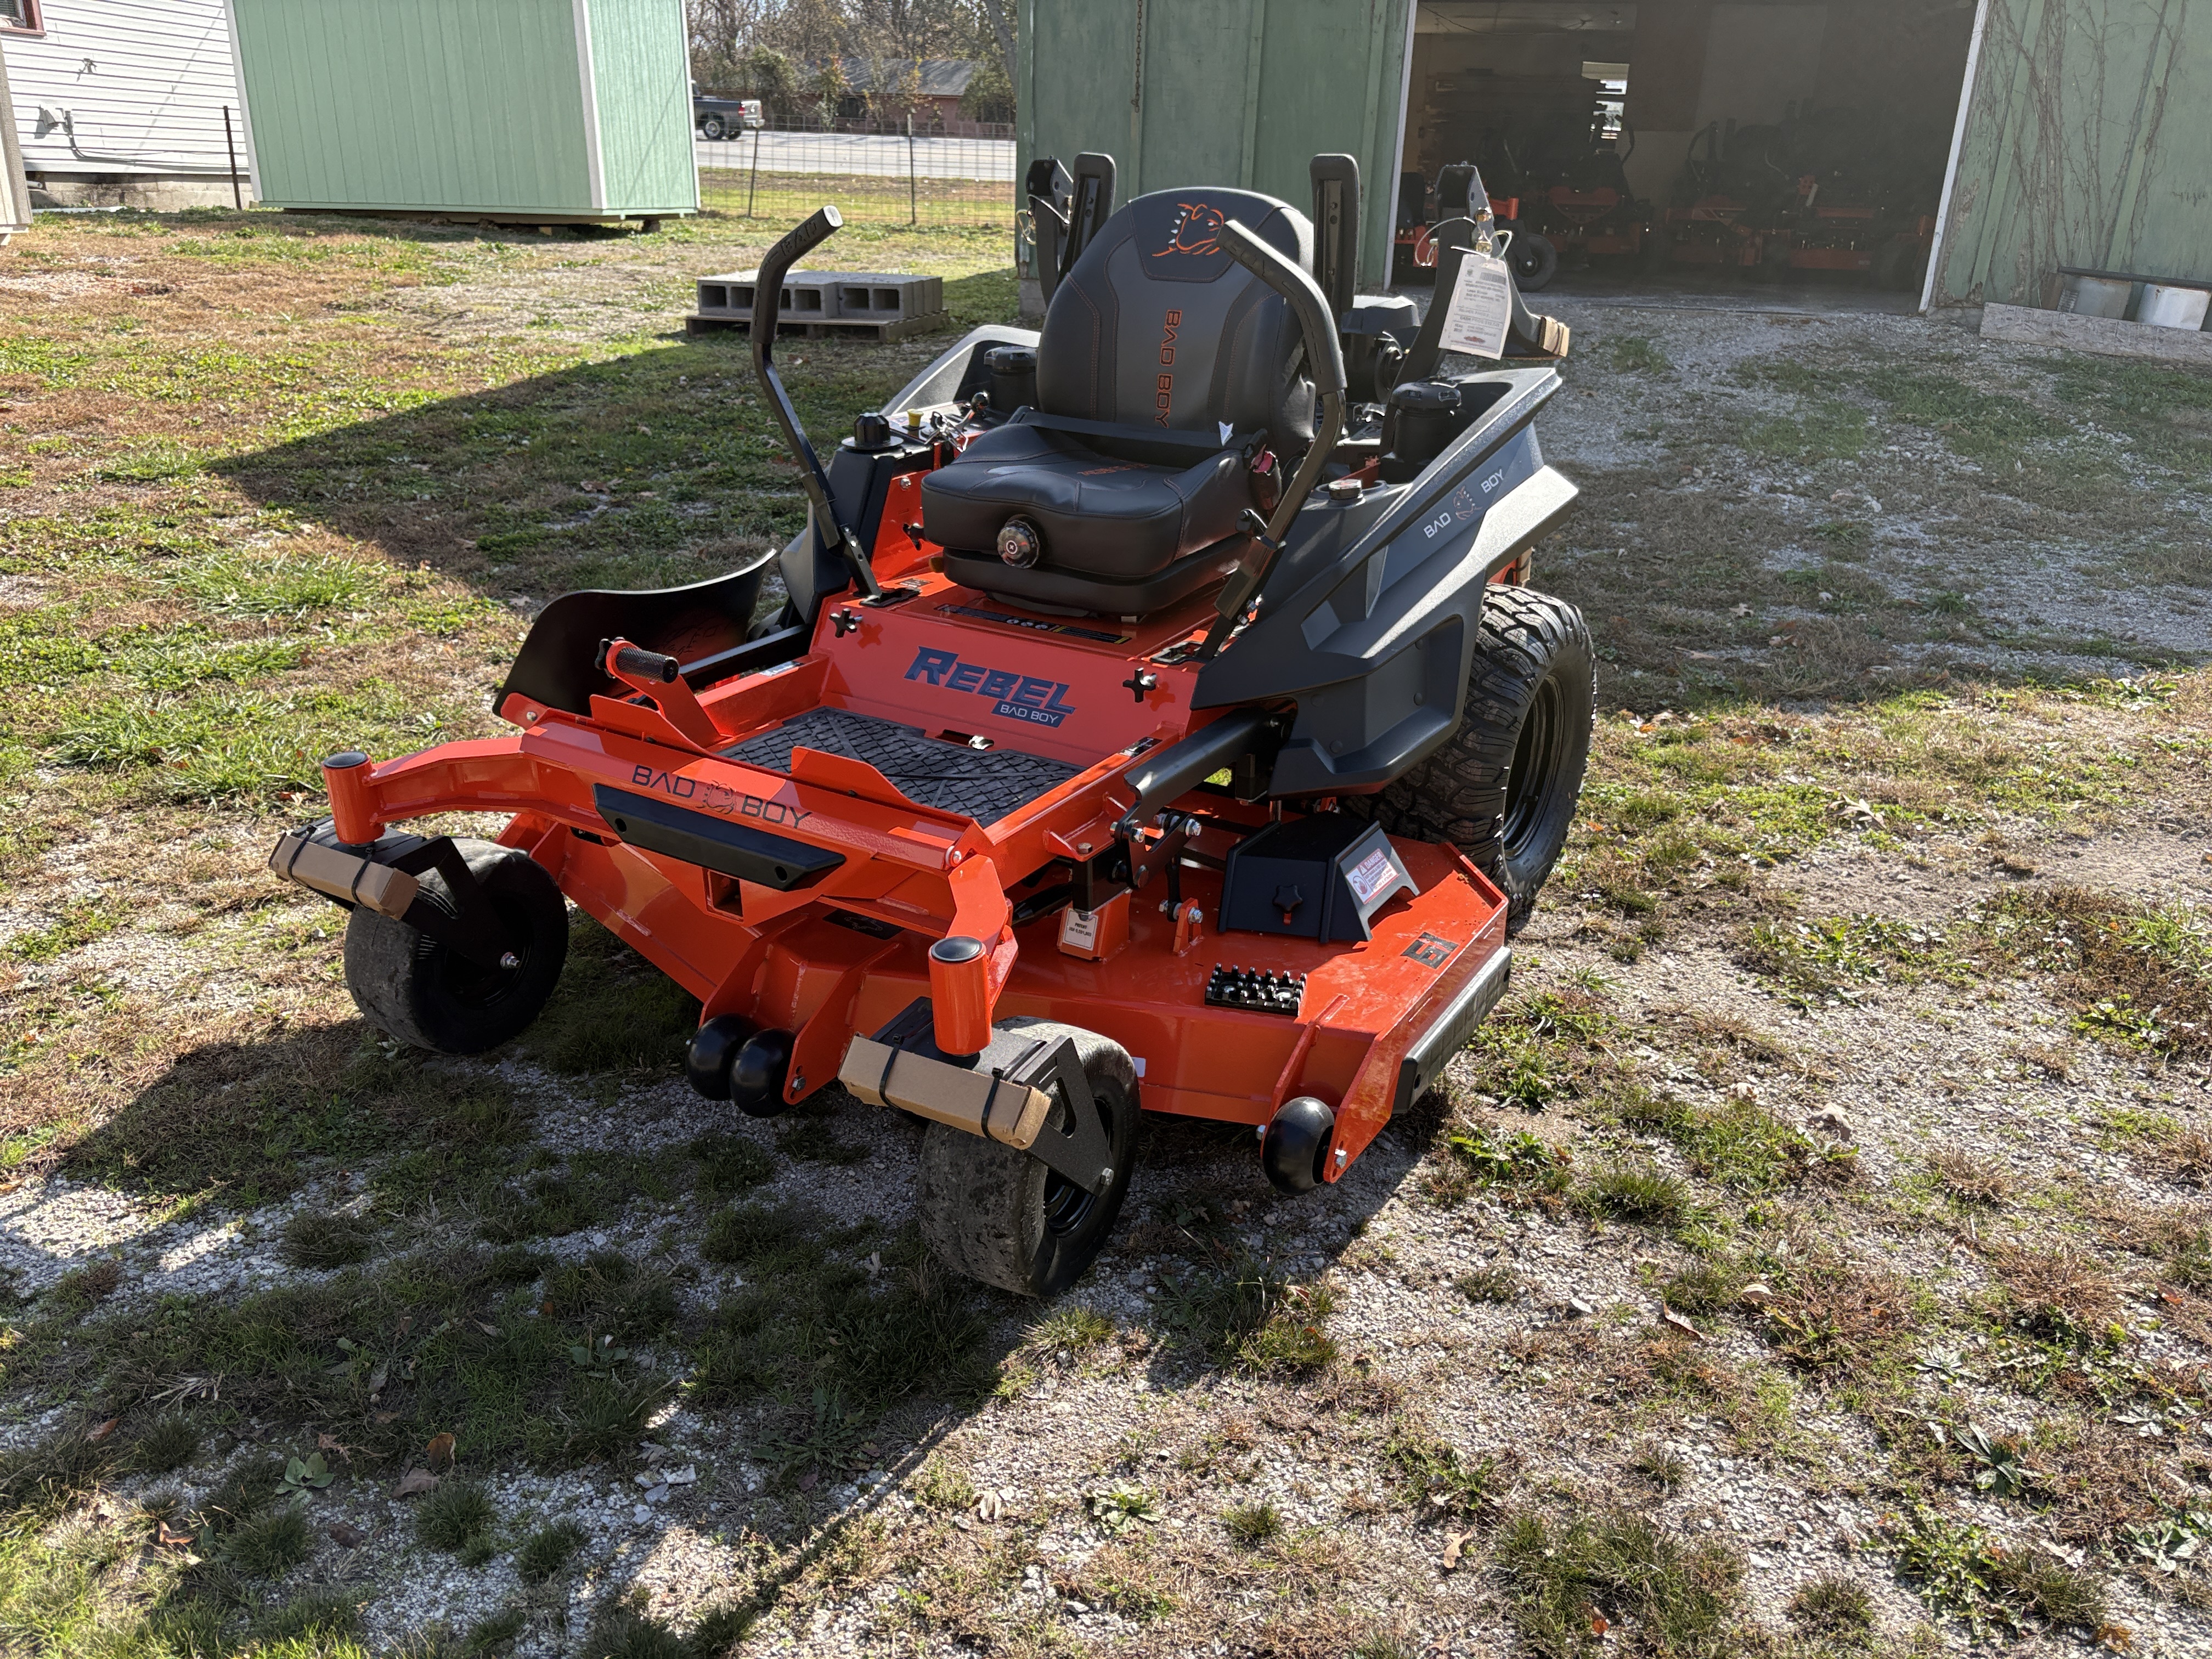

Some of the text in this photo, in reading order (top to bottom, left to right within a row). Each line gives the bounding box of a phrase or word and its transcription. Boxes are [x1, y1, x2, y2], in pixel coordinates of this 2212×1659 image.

[1155, 309, 1183, 428] BAD BOY
[1423, 469, 1504, 539] BAD BOY
[904, 646, 1077, 714] REBEL
[1000, 704, 1059, 724] BAD BOY
[631, 765, 812, 828] BAD BOY
[1364, 851, 1383, 869] DANGER
[1400, 932, 1459, 969] 61
